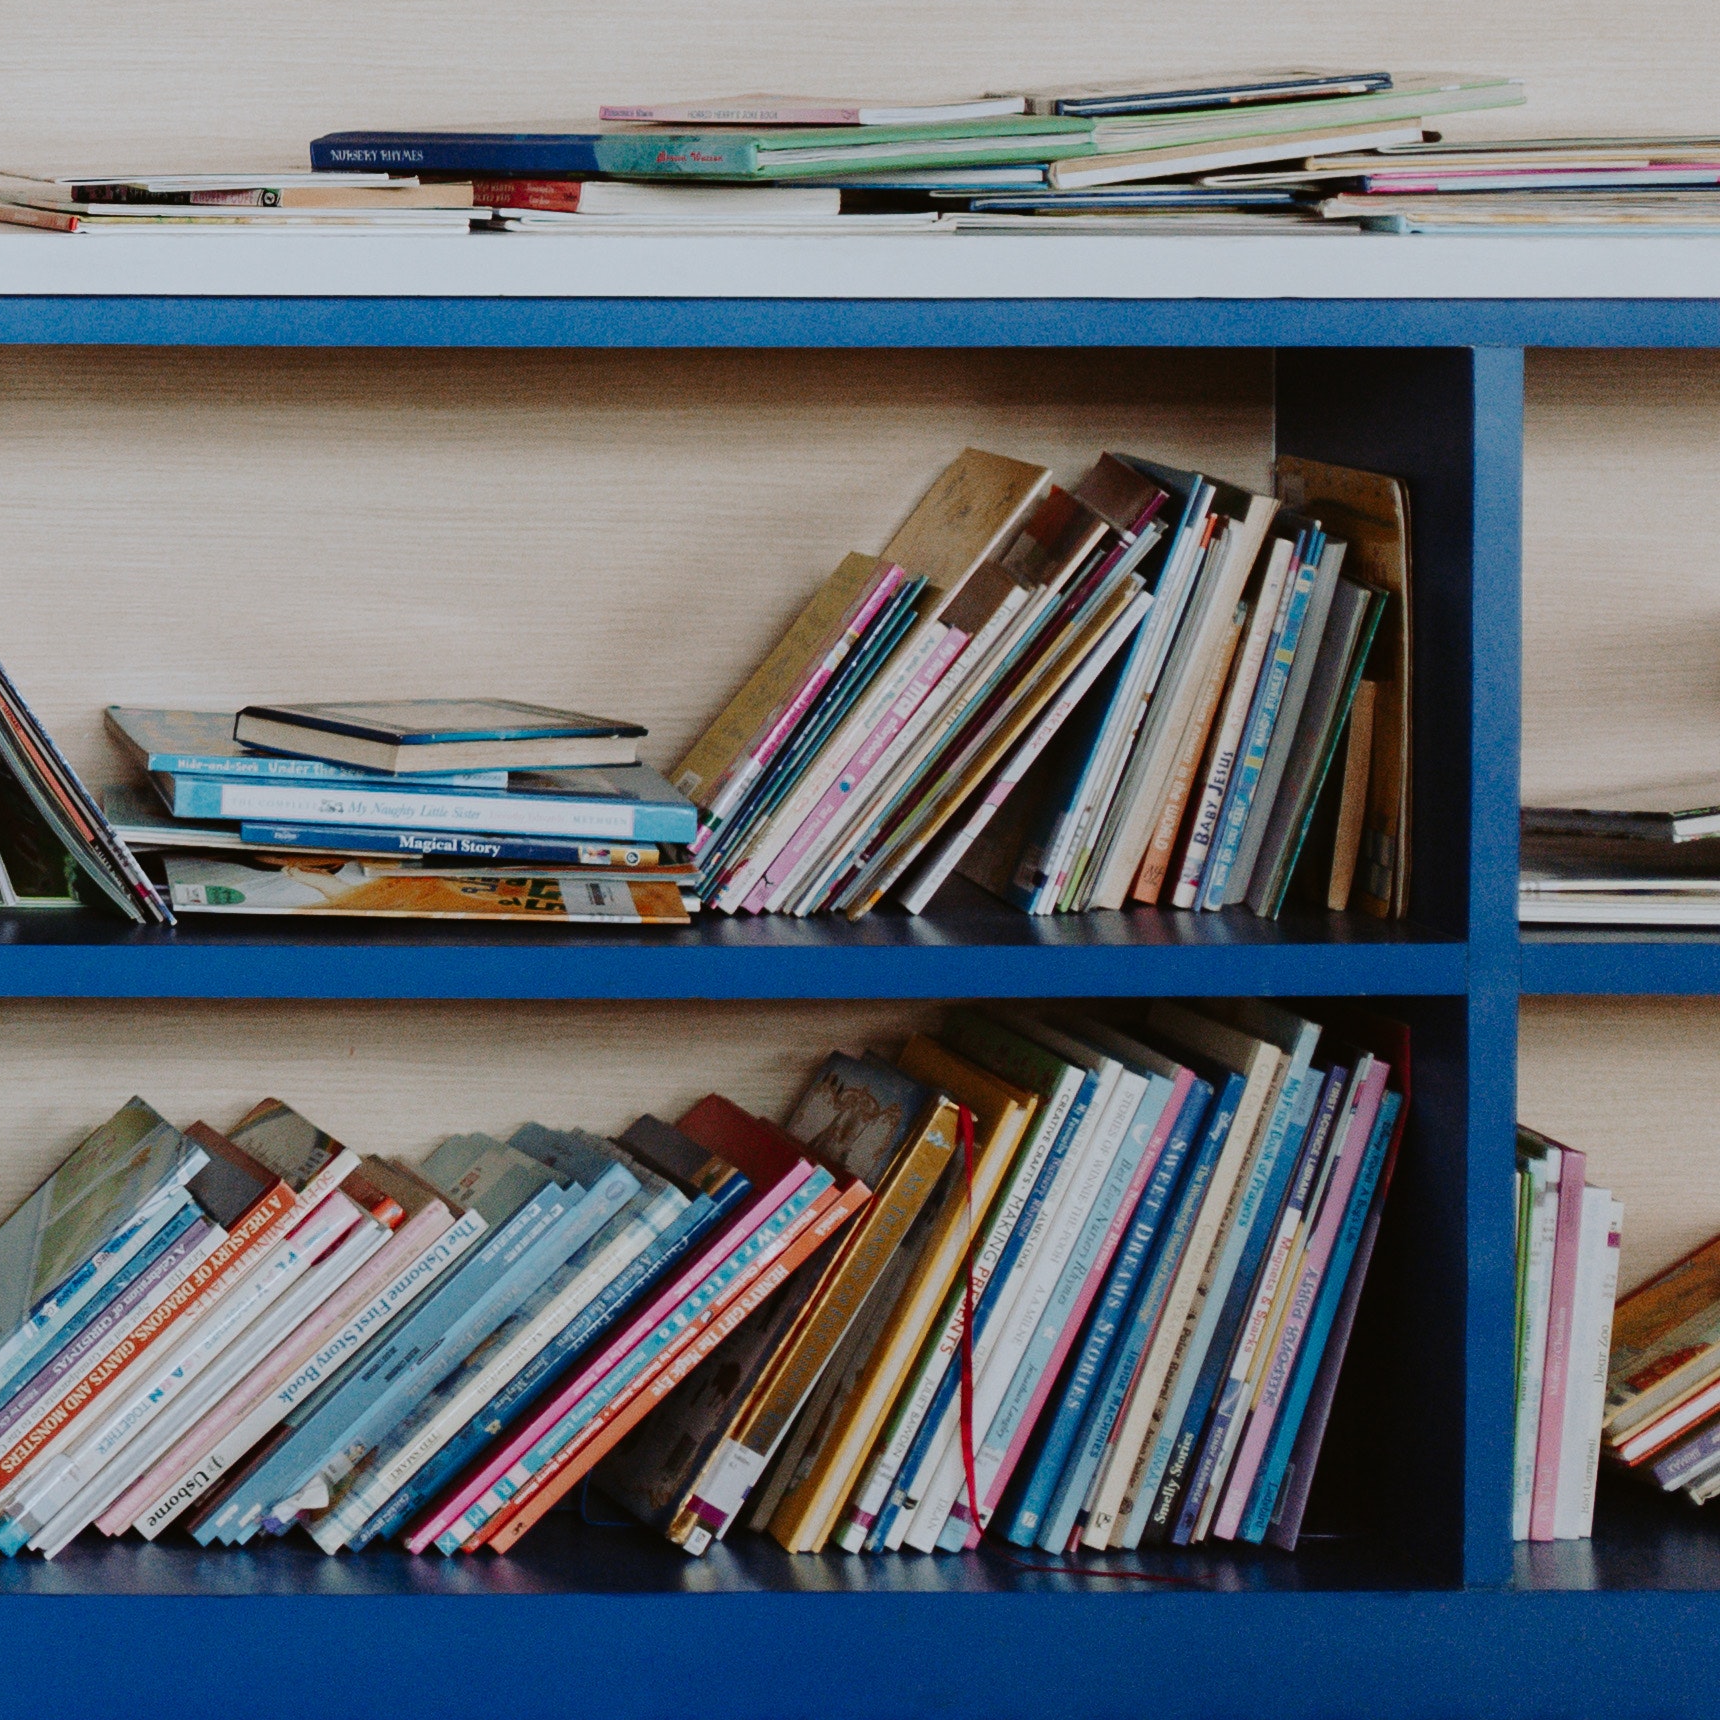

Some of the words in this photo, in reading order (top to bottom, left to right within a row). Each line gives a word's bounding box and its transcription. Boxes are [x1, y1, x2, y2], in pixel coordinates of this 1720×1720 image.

[330, 149, 378, 162] NURSERY
[380, 149, 423, 162] RHYMES
[348, 800, 368, 816] My
[372, 801, 415, 819] Naughty
[420, 804, 449, 818] Little
[454, 806, 481, 820] Sister
[1192, 798, 1220, 846] BABY
[1206, 747, 1235, 796] JESUS
[399, 835, 458, 854] Magical
[460, 839, 501, 857] Story
[1278, 1075, 1301, 1101] My
[1324, 1080, 1342, 1110] FIRST
[1040, 1091, 1071, 1143] CREATIVE
[1105, 1089, 1134, 1138] STORIES
[1272, 1099, 1293, 1129] First
[1096, 1137, 1113, 1157] OF
[1260, 1129, 1283, 1163] Book
[1308, 1111, 1332, 1157] SCIENCE
[1020, 1143, 1047, 1185] CRAFTS
[1112, 1156, 1133, 1183] Best
[1144, 1135, 1189, 1213] SWEET
[1255, 1162, 1271, 1177] of
[1294, 1157, 1317, 1201] LIBRARY
[266, 1193, 283, 1210] A
[1099, 1181, 1122, 1211] Ever
[1233, 1175, 1266, 1229] Prayers
[206, 1202, 274, 1271] TREASURY
[445, 1217, 478, 1249] The
[981, 1192, 1024, 1265] MAKING
[1027, 1208, 1049, 1242] JAMES
[1074, 1209, 1110, 1262] Nursery
[172, 1242, 189, 1259] A
[182, 1248, 207, 1272] Eric
[1014, 1241, 1035, 1272] COOK
[1104, 1220, 1155, 1312] DREAMS
[1261, 1234, 1292, 1292] Magnets
[120, 1252, 179, 1309] Celebration
[163, 1268, 186, 1291] Hill
[189, 1263, 214, 1287] OF
[385, 1242, 451, 1306] Usborne
[738, 1261, 788, 1311] HENRY'S
[1054, 1258, 1088, 1308] Rhymes
[108, 1301, 127, 1320] of
[126, 1299, 153, 1325] Spot
[128, 1278, 196, 1347] DRAGONS,
[352, 1297, 392, 1336] First
[715, 1303, 746, 1334] GIFT
[1258, 1294, 1272, 1307] &
[112, 1320, 133, 1342] and
[198, 1294, 256, 1351] TOGETHER
[695, 1328, 721, 1353] The
[1241, 1308, 1268, 1355] Sparks
[1596, 1322, 1610, 1349] Zoo
[49, 1313, 115, 1377] CHRISTMAS
[87, 1337, 137, 1388] GIANTS
[98, 1337, 116, 1355] his
[311, 1326, 359, 1373] Story
[667, 1345, 702, 1380] Magic
[41, 1348, 103, 1409] Grandparents
[1010, 1361, 1039, 1405] Jonathan
[1064, 1317, 1115, 1413] STORIES
[1114, 1349, 1139, 1391] INSIDE
[1593, 1350, 1607, 1384] Dear
[61, 1379, 95, 1413] AND
[276, 1364, 321, 1408] Book
[648, 1373, 675, 1399] Eye
[912, 1377, 937, 1412] JULIET
[19, 1417, 33, 1431] to
[29, 1404, 47, 1422] Go
[94, 1399, 151, 1455] TOGETHER
[994, 1403, 1019, 1441] Langley
[1088, 1393, 1122, 1460] MACHINES
[5, 1427, 24, 1446] the
[890, 1409, 921, 1459] BAWDEN
[1152, 1476, 1182, 1525] Smelly
[1168, 1429, 1196, 1478] Stories
[1583, 1438, 1599, 1489] Campbell
[144, 1468, 210, 1530] Usborne
[925, 1497, 948, 1532] DEAN
[1252, 1480, 1278, 1528] Ladybird
[1581, 1491, 1592, 1514] Rod
